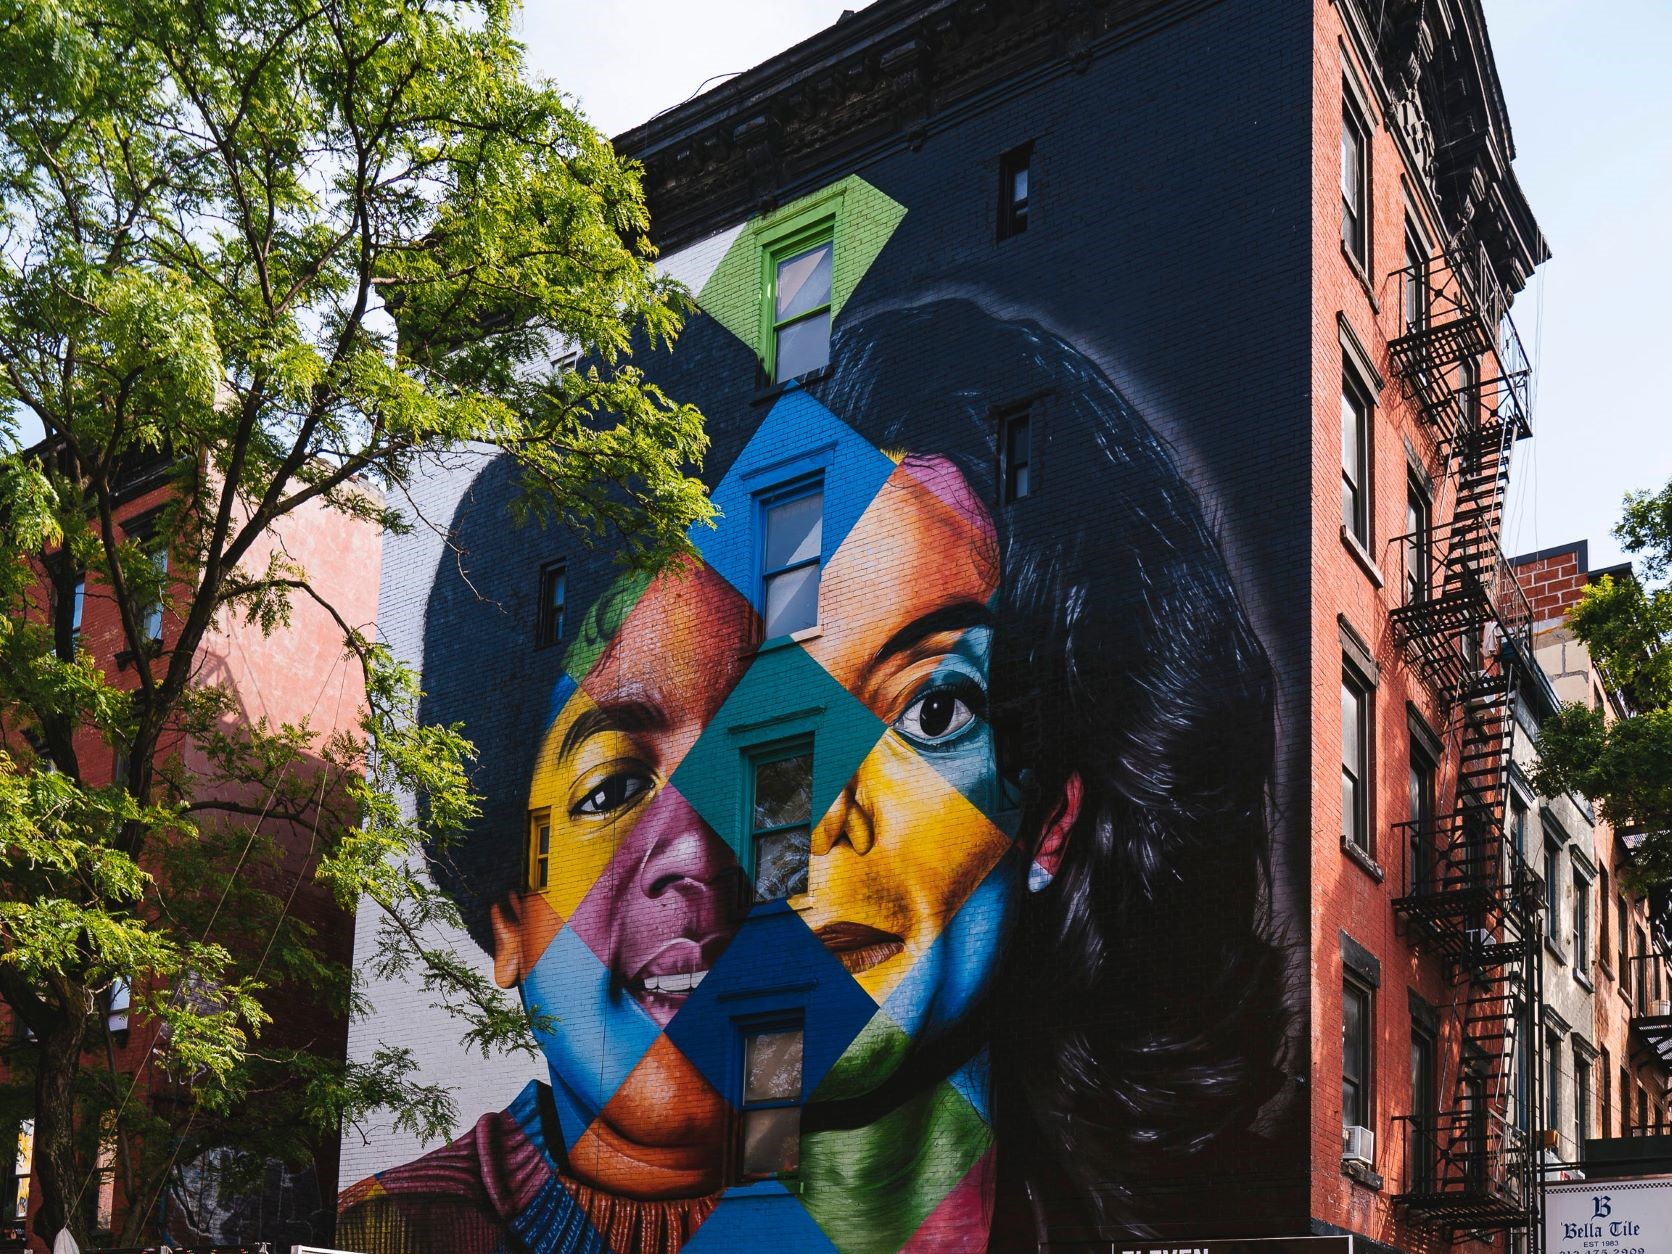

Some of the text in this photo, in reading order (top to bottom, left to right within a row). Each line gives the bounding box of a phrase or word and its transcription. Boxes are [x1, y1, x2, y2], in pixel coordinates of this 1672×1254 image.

[1591, 1196, 1611, 1221] B
[1561, 1220, 1640, 1241] Bella Tile
